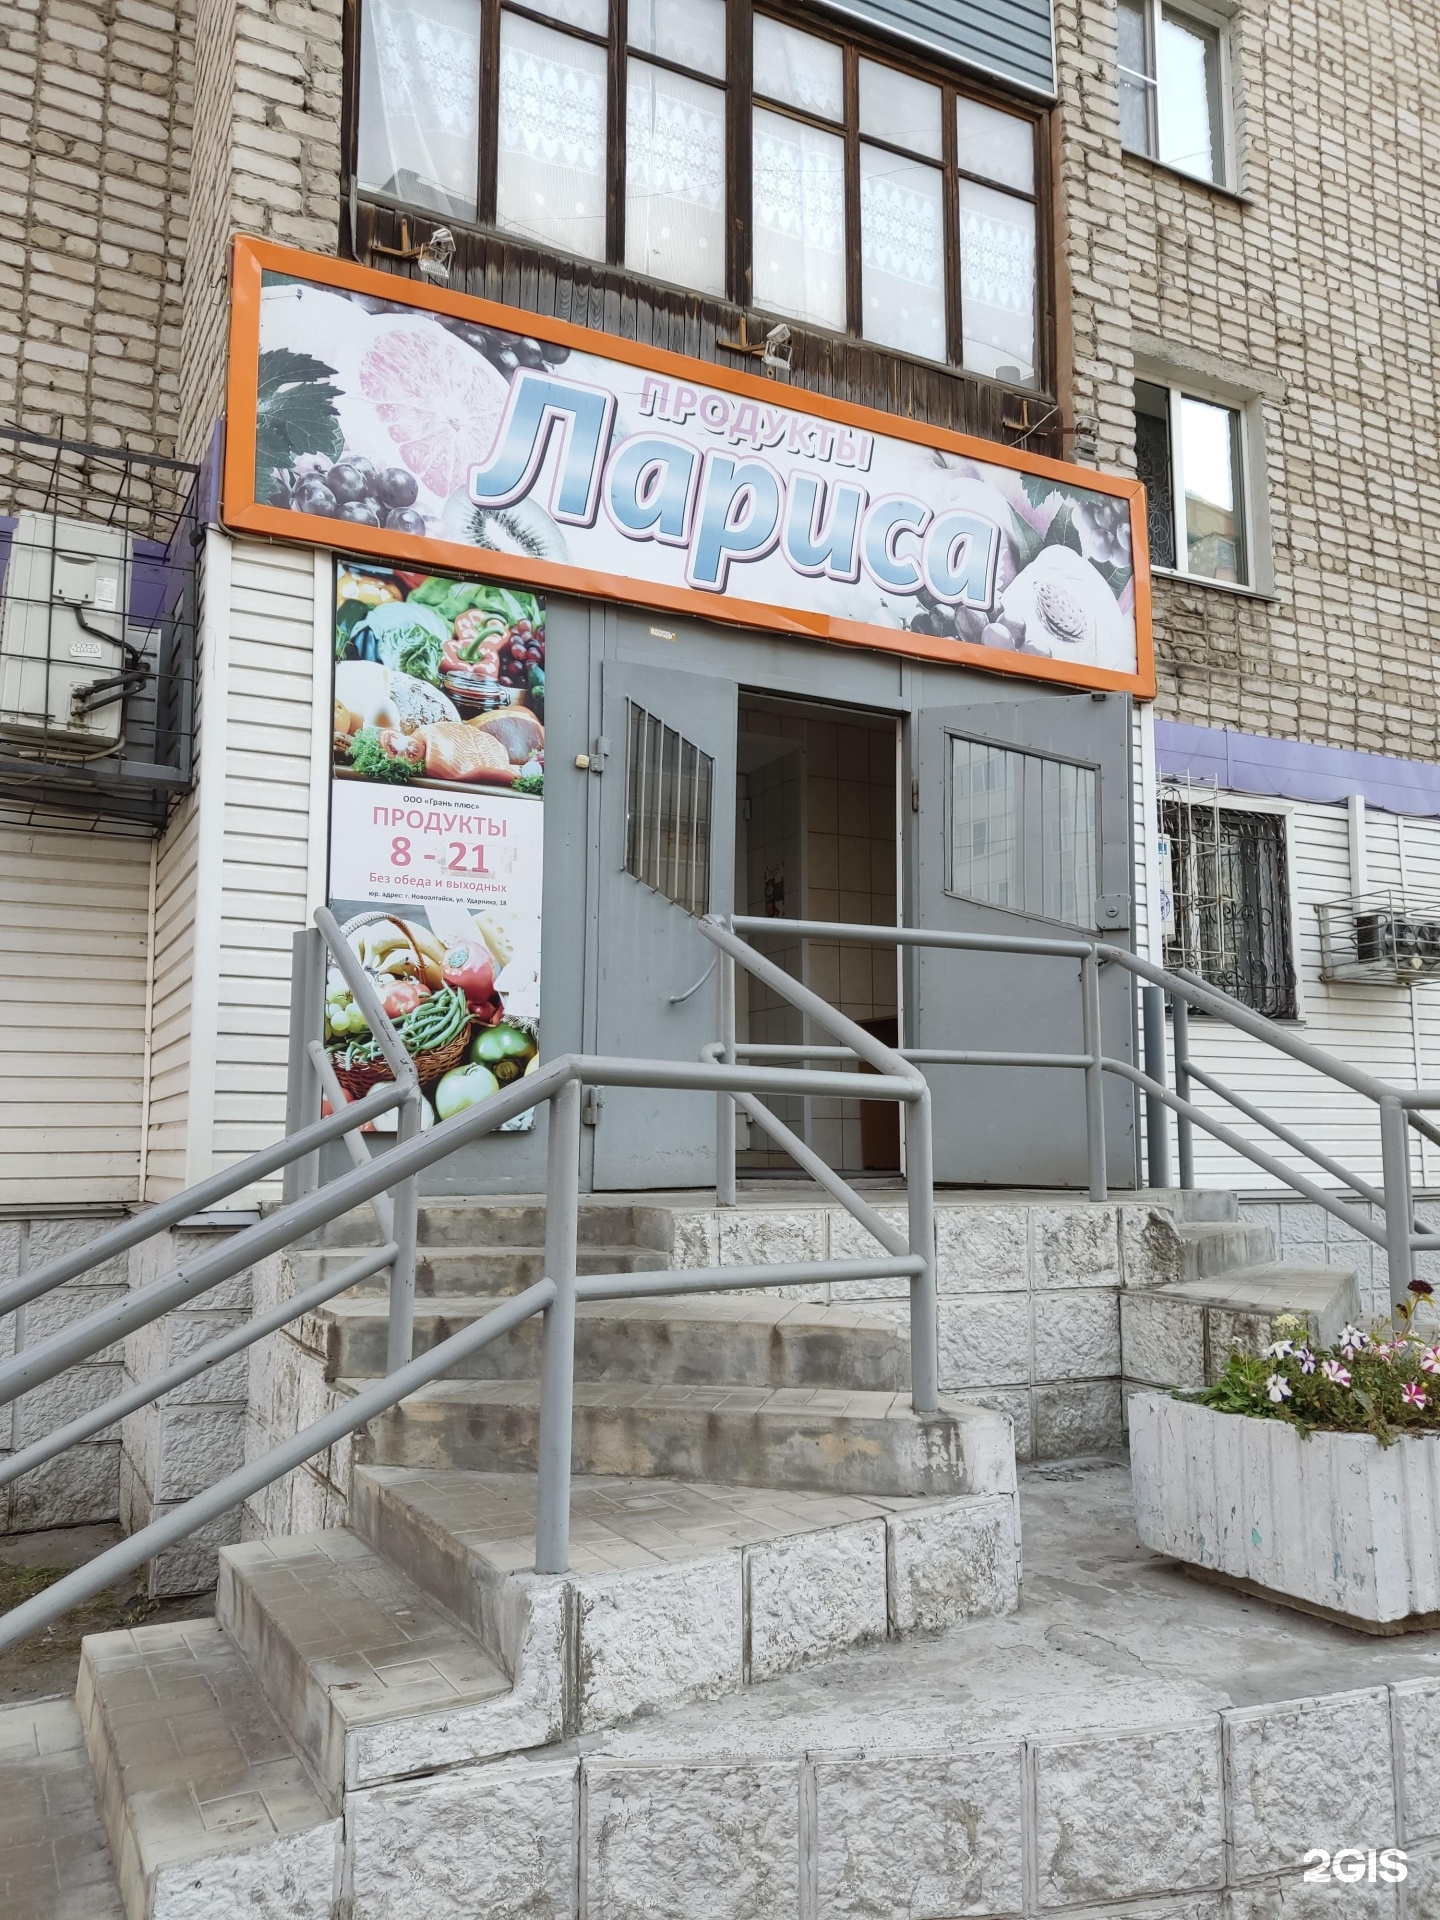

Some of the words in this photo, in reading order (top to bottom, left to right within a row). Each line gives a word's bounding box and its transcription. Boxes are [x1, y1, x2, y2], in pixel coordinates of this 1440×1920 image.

[638, 376, 874, 471] ПРОДУКТЫ
[467, 366, 1001, 614] Лариса
[403, 795, 422, 803] ООО
[424, 798, 452, 807] «Грань
[373, 806, 507, 837] ПРОДУКТЫ
[390, 836, 412, 866] 8
[448, 842, 489, 873] 21
[369, 872, 390, 884] Без
[394, 874, 431, 888] обеда
[446, 880, 507, 892] выходных
